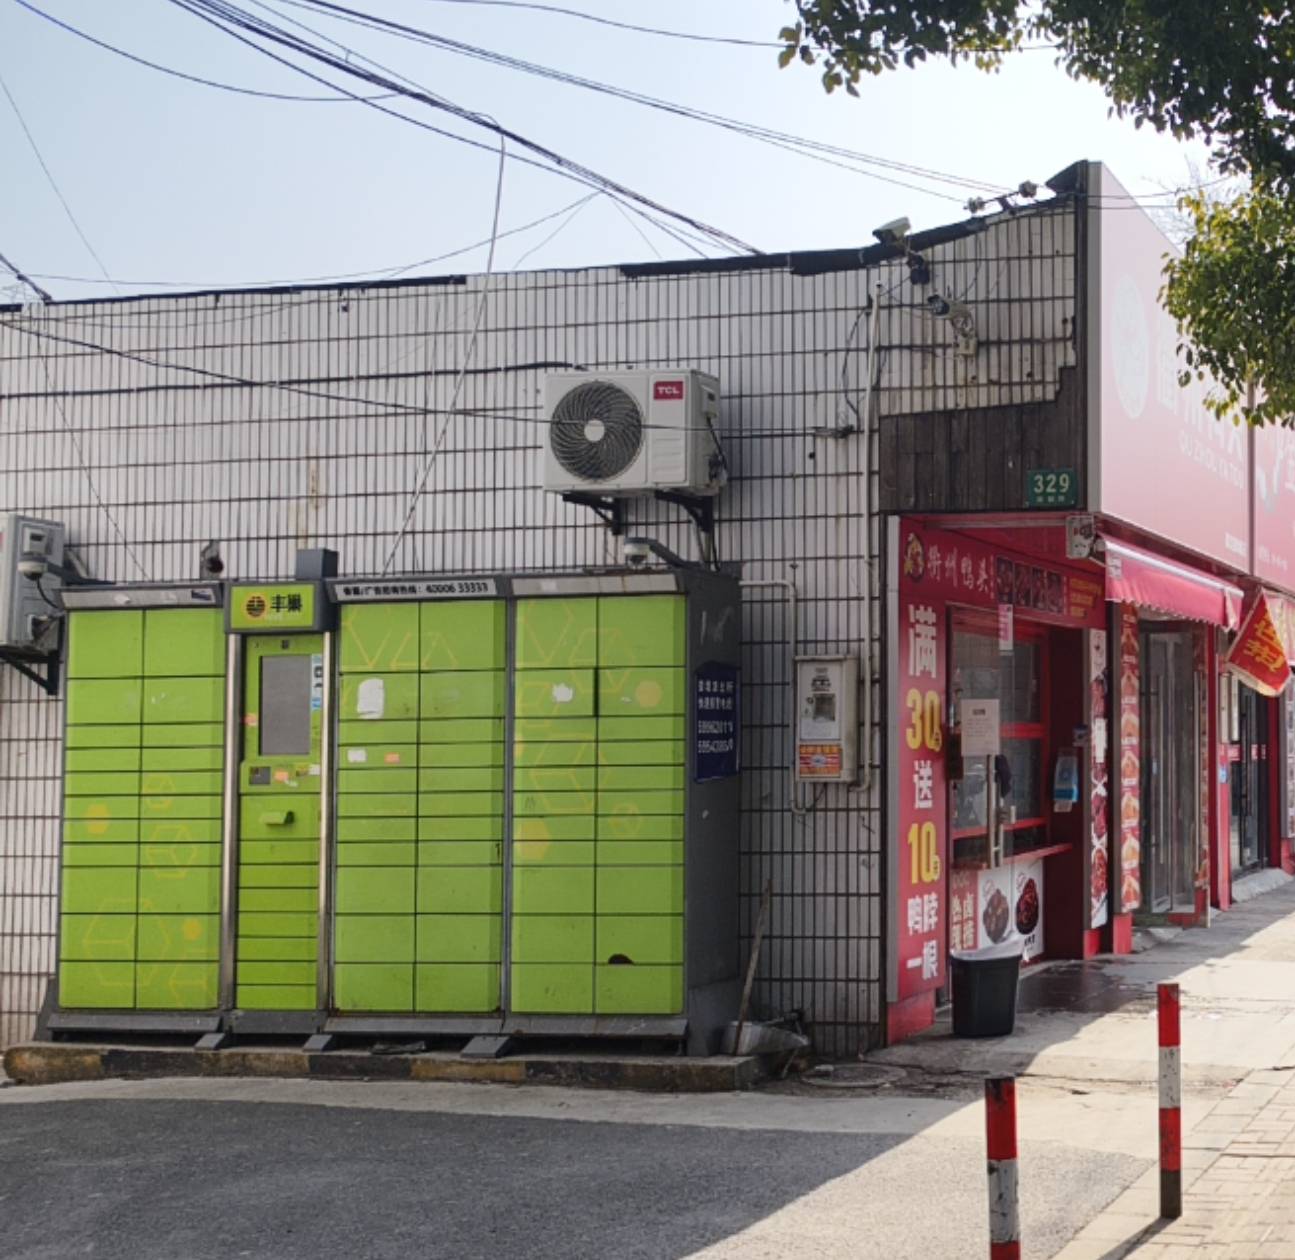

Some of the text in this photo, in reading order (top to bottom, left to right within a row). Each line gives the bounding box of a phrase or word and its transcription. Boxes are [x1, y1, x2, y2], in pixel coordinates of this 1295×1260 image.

[656, 386, 681, 394] TCL
[1033, 473, 1070, 493] 329
[458, 582, 488, 593] 33333
[270, 593, 303, 613] 丰巢
[909, 603, 937, 678] 满
[912, 760, 933, 809] 送
[907, 891, 939, 936] 鸭脖
